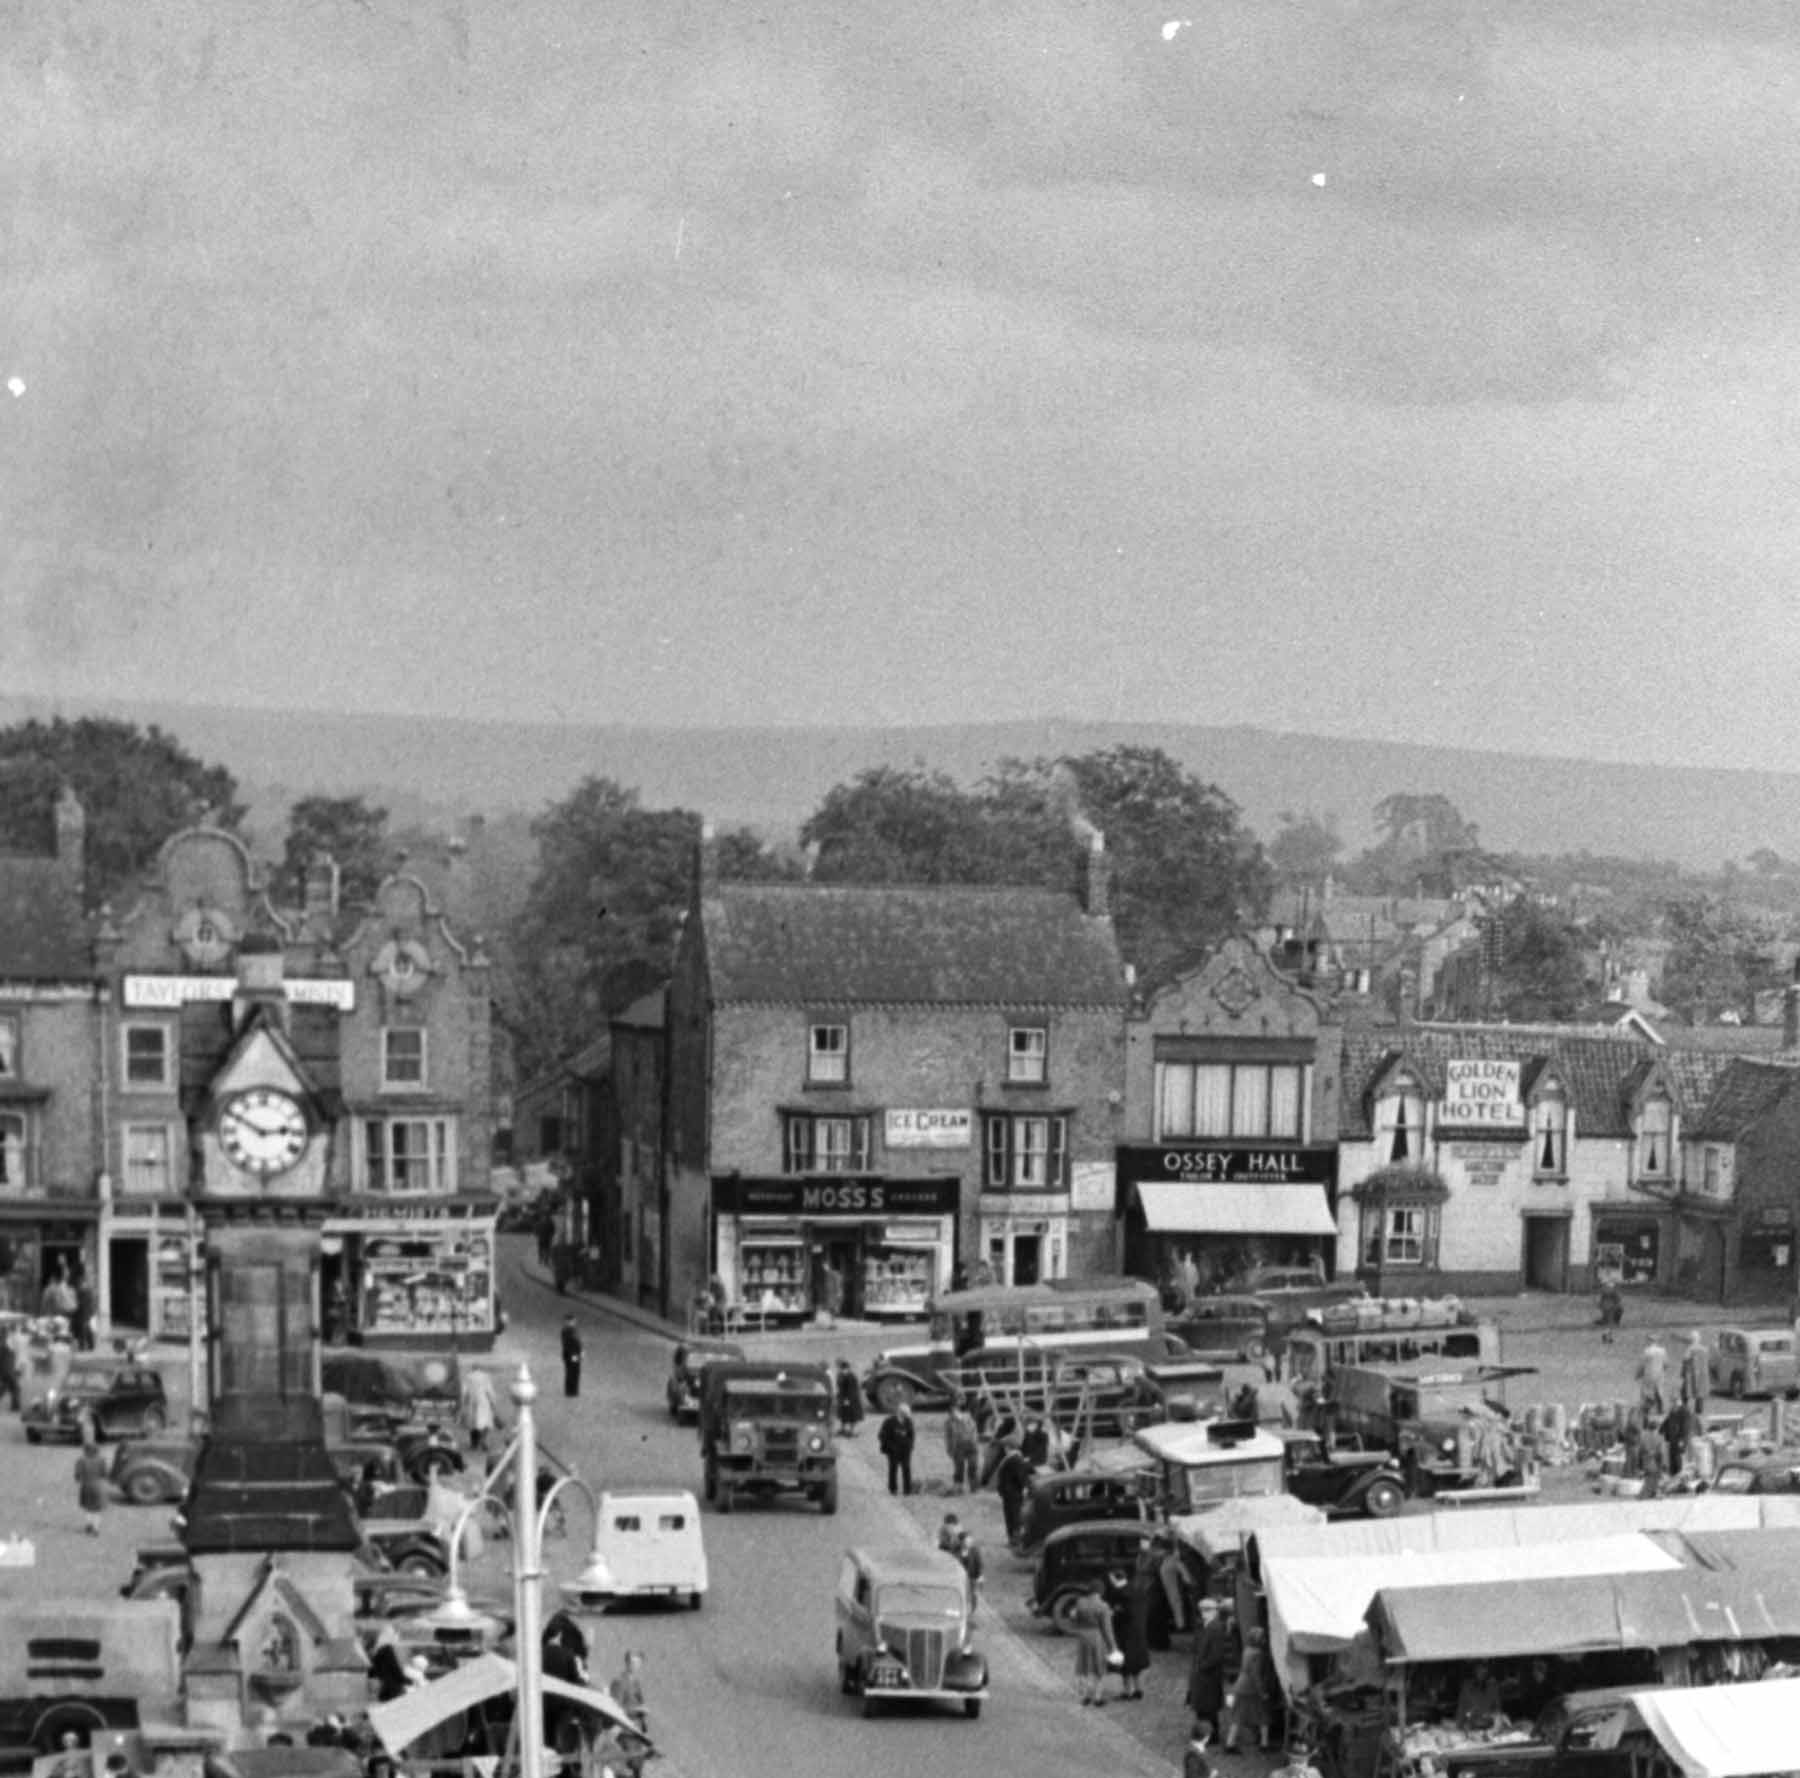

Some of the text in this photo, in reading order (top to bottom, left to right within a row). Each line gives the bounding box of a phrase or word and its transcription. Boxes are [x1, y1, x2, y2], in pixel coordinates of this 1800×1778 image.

[1448, 1064, 1517, 1082] GOLDEN
[1460, 1083, 1505, 1099] LION
[1442, 1103, 1520, 1120] HOTEL
[888, 1111, 969, 1131] ICE CREAM
[1163, 1152, 1304, 1172] OSSEY HALL
